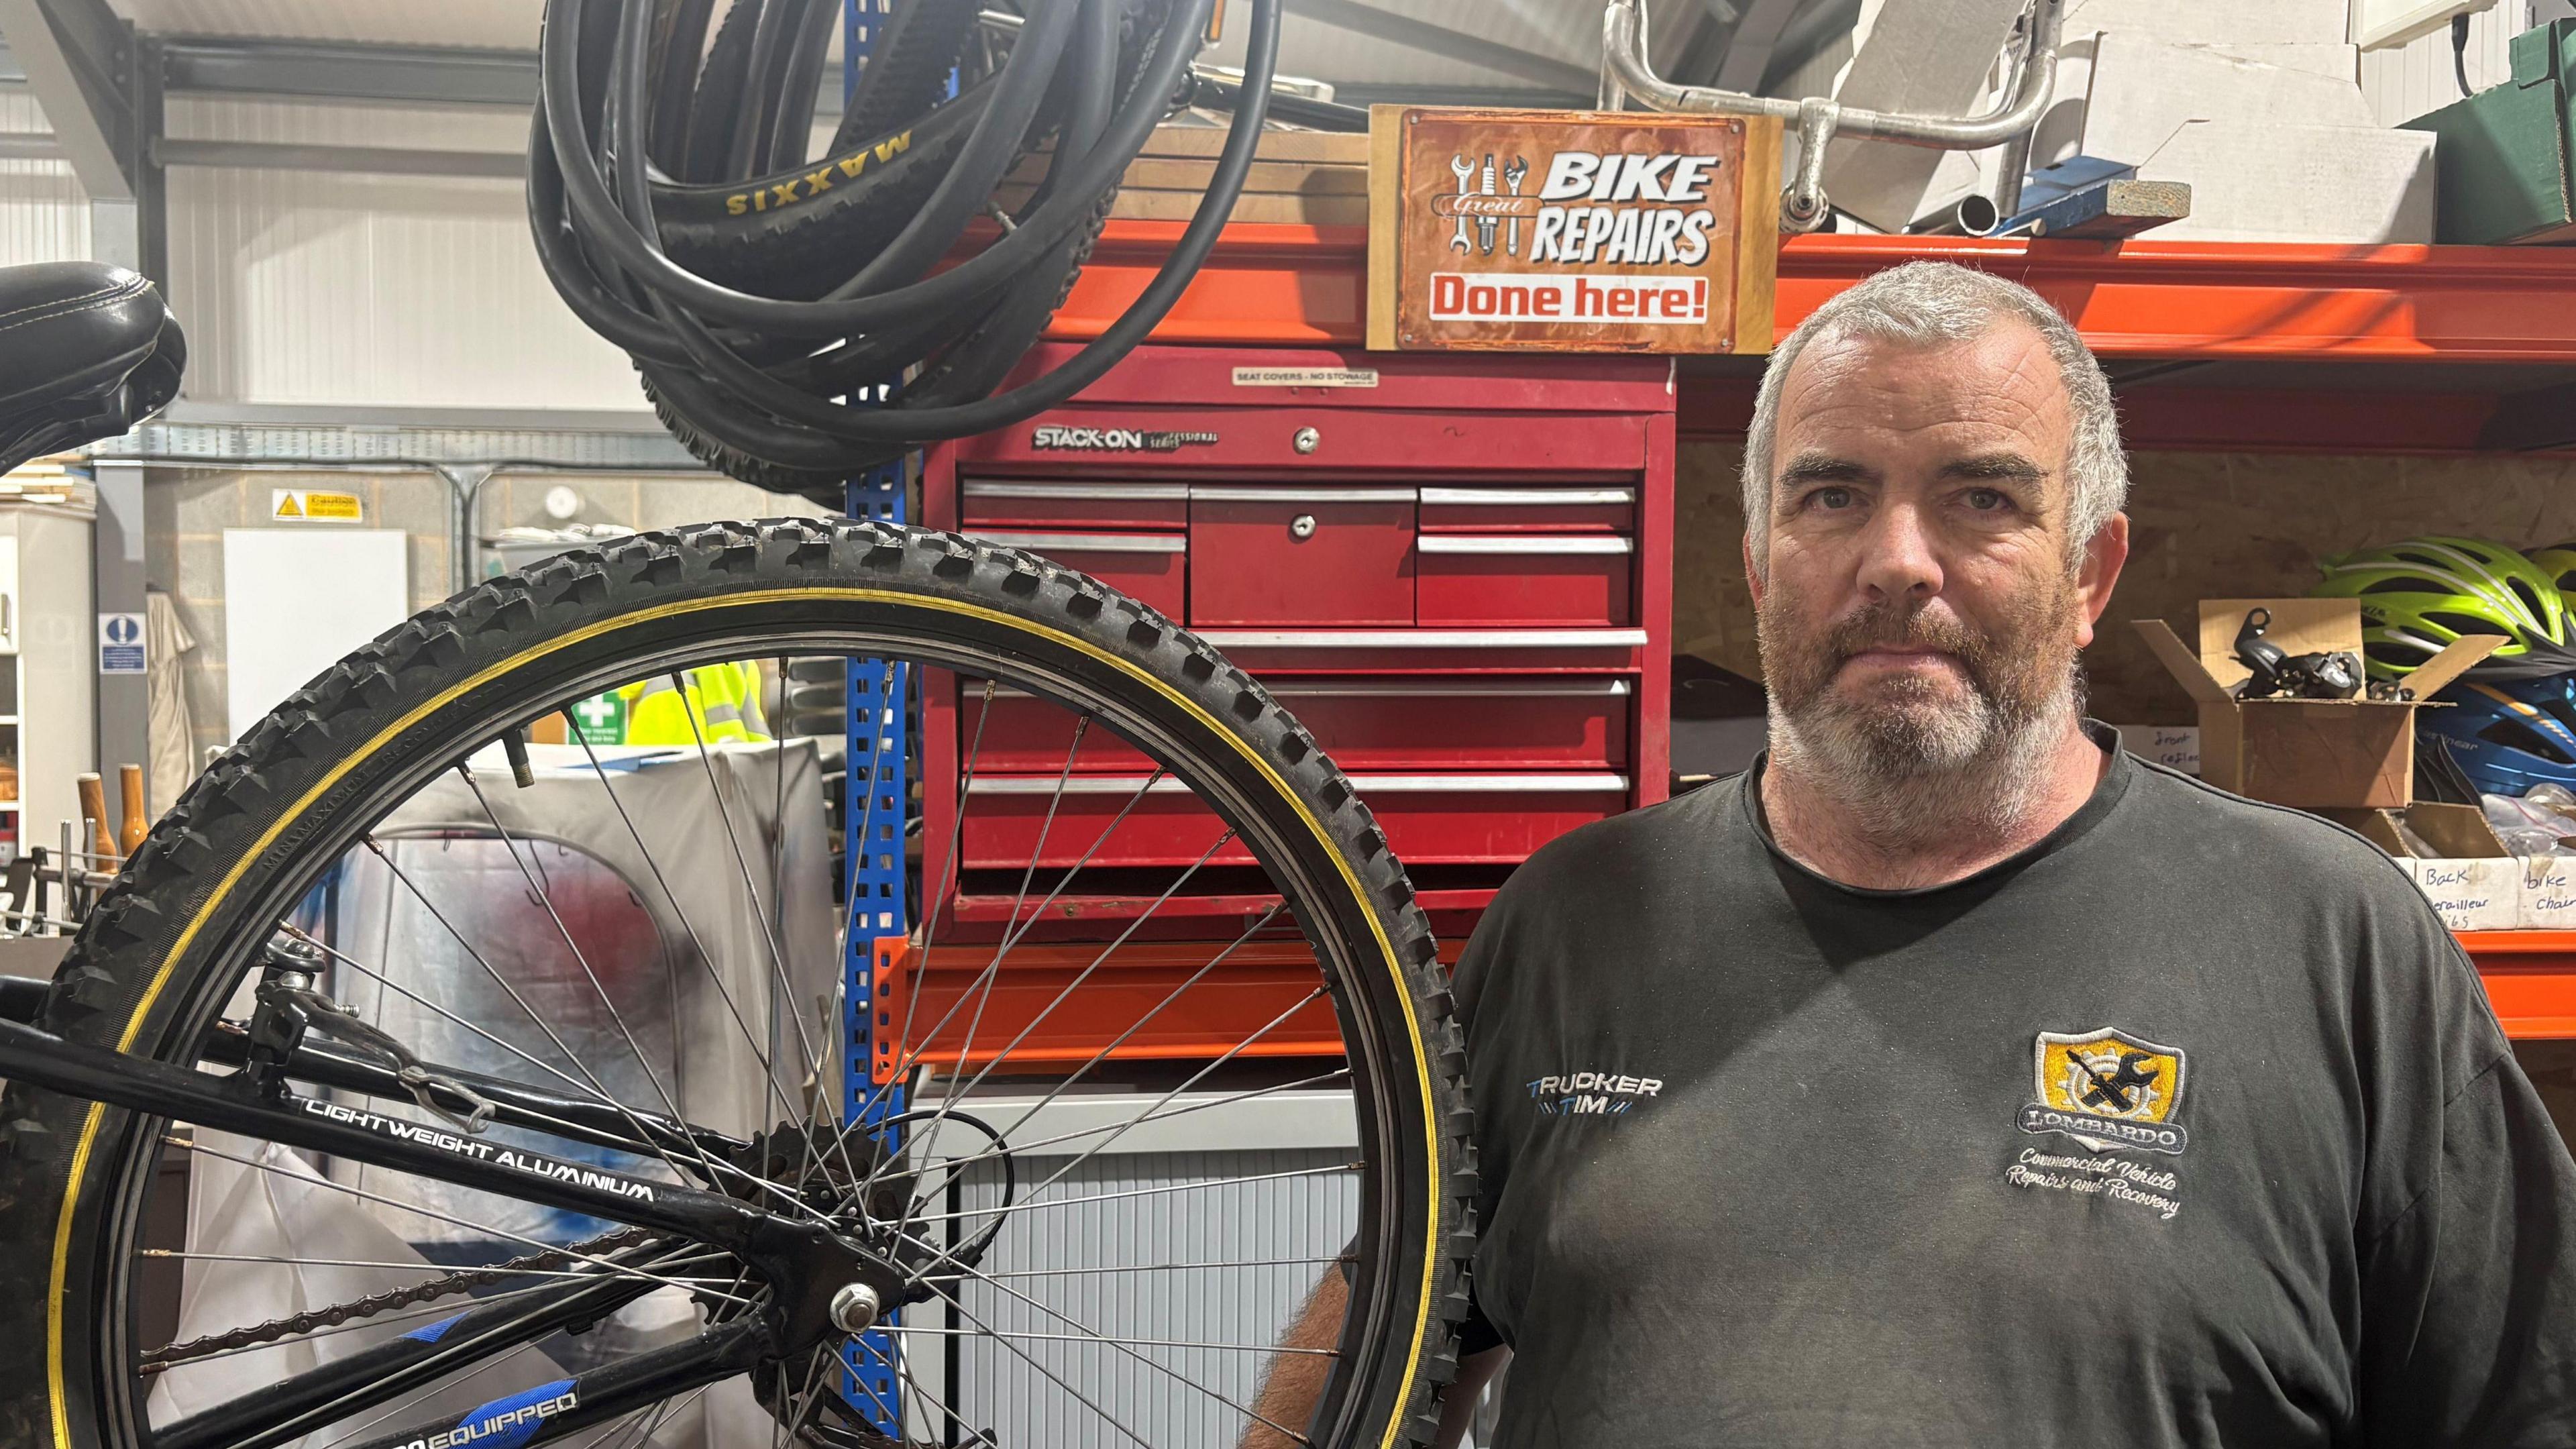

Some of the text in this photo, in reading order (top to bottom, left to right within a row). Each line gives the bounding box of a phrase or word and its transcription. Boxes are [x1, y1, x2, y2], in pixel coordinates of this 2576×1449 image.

[727, 130, 912, 215] MAXXIS
[1540, 151, 1720, 203] BIKE
[1439, 192, 1524, 220] Great
[1529, 207, 1716, 266] REPAIRS
[1433, 275, 1707, 318] Done here!
[1237, 373, 1261, 381] SEAT
[1263, 373, 1303, 381] COVERS
[1034, 427, 1142, 449] STACK-ON
[2161, 753, 2200, 763] reflec
[2426, 869, 2469, 885] Back
[2434, 900, 2489, 911] erailleur
[1526, 1072, 1663, 1097] TRUCKER
[1559, 1095, 1609, 1116] TIM
[2027, 1110, 2178, 1146] LOMBARDO
[495, 1150, 654, 1203] ALUMINIUM
[2019, 1148, 2178, 1191] Commercial Vehicle
[2005, 1165, 2180, 1219] Repairs and Recovery
[428, 1392, 577, 1449] EQUIPPED
